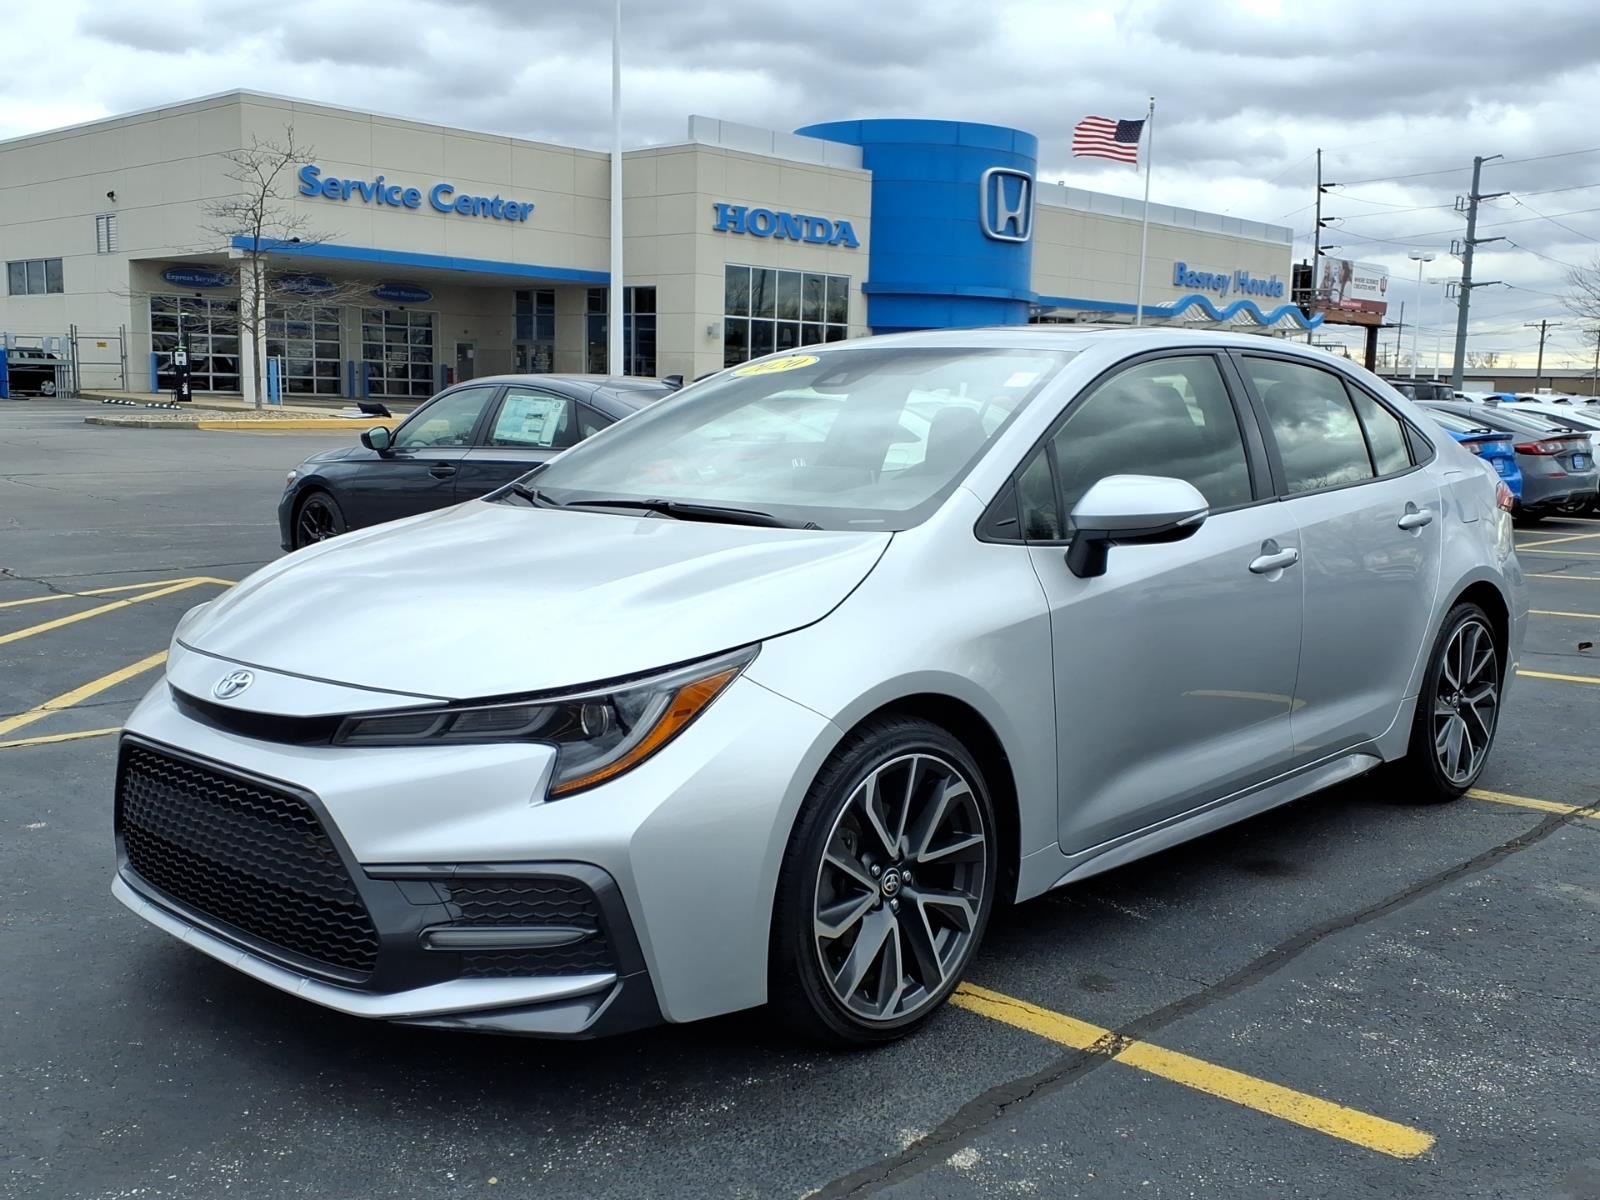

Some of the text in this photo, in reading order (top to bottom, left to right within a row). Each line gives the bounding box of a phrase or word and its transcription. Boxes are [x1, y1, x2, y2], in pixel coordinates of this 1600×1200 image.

[299, 164, 535, 222] Service Center
[713, 202, 860, 248] HONDA
[166, 272, 193, 283] Express
[1173, 261, 1284, 298] Basney Honda
